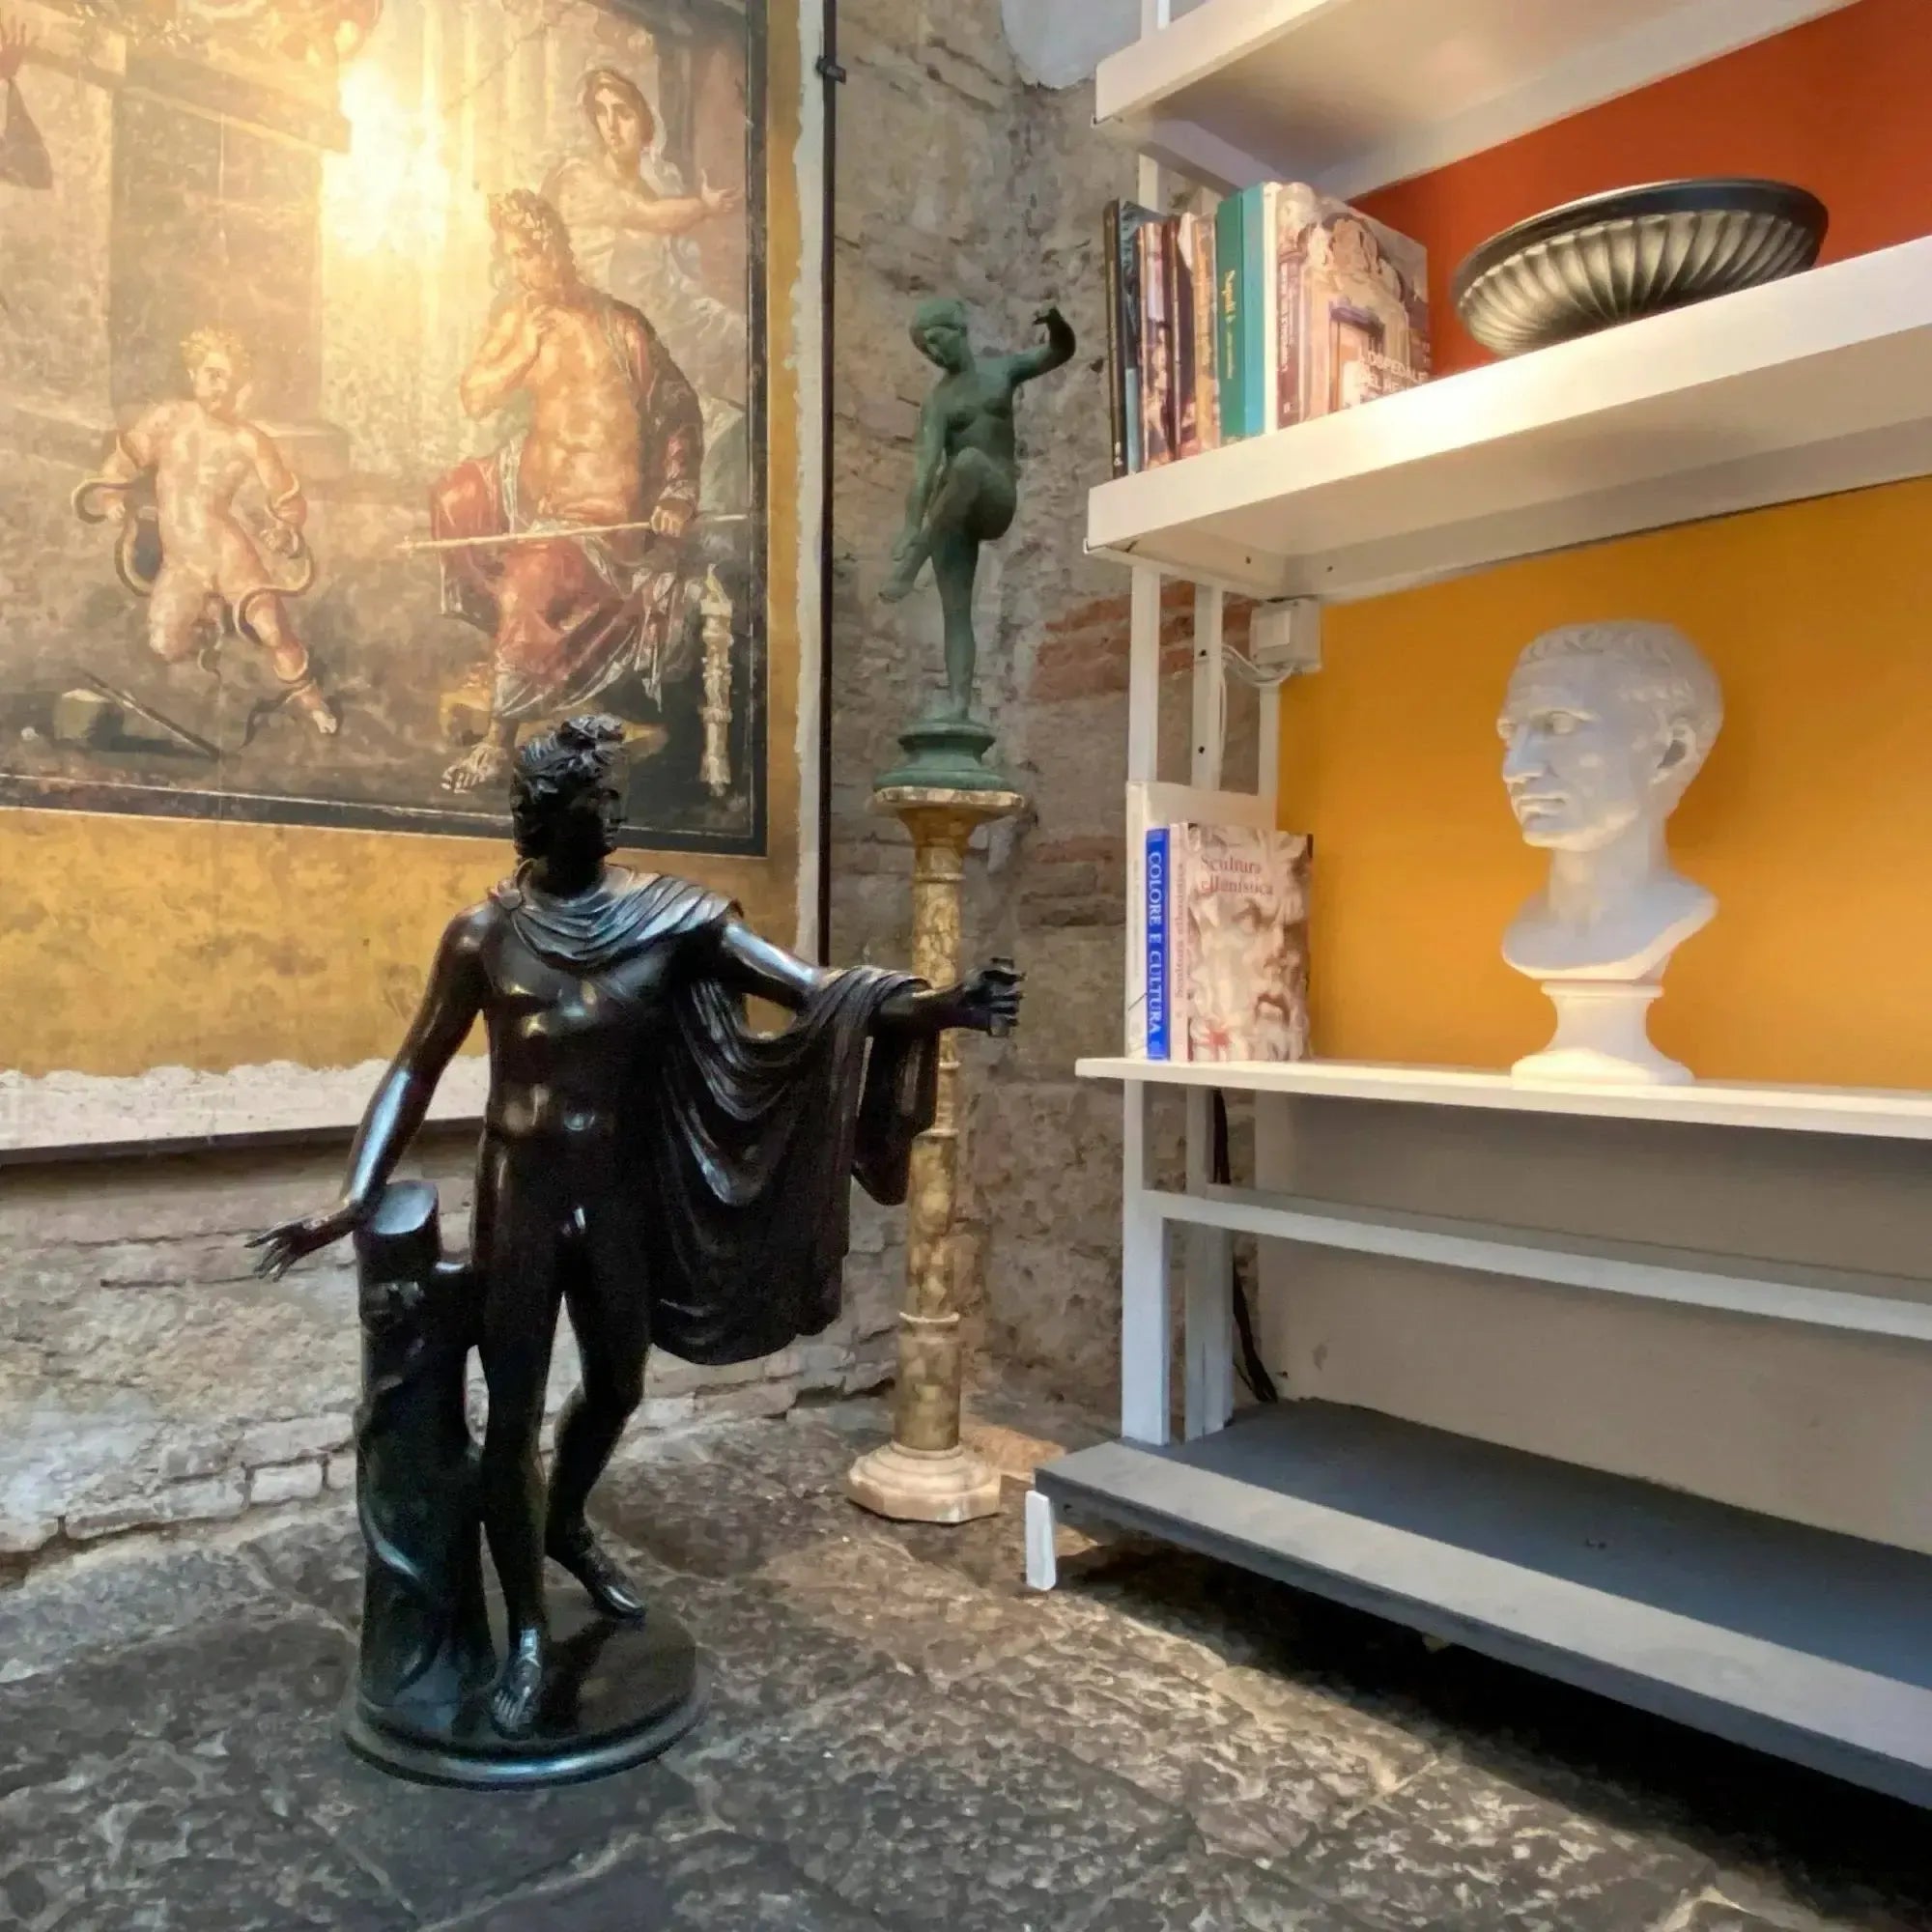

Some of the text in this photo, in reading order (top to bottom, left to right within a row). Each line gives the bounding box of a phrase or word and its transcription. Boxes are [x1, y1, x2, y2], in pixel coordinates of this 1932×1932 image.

[1148, 851, 1163, 1035] COLORE E CULTURA
